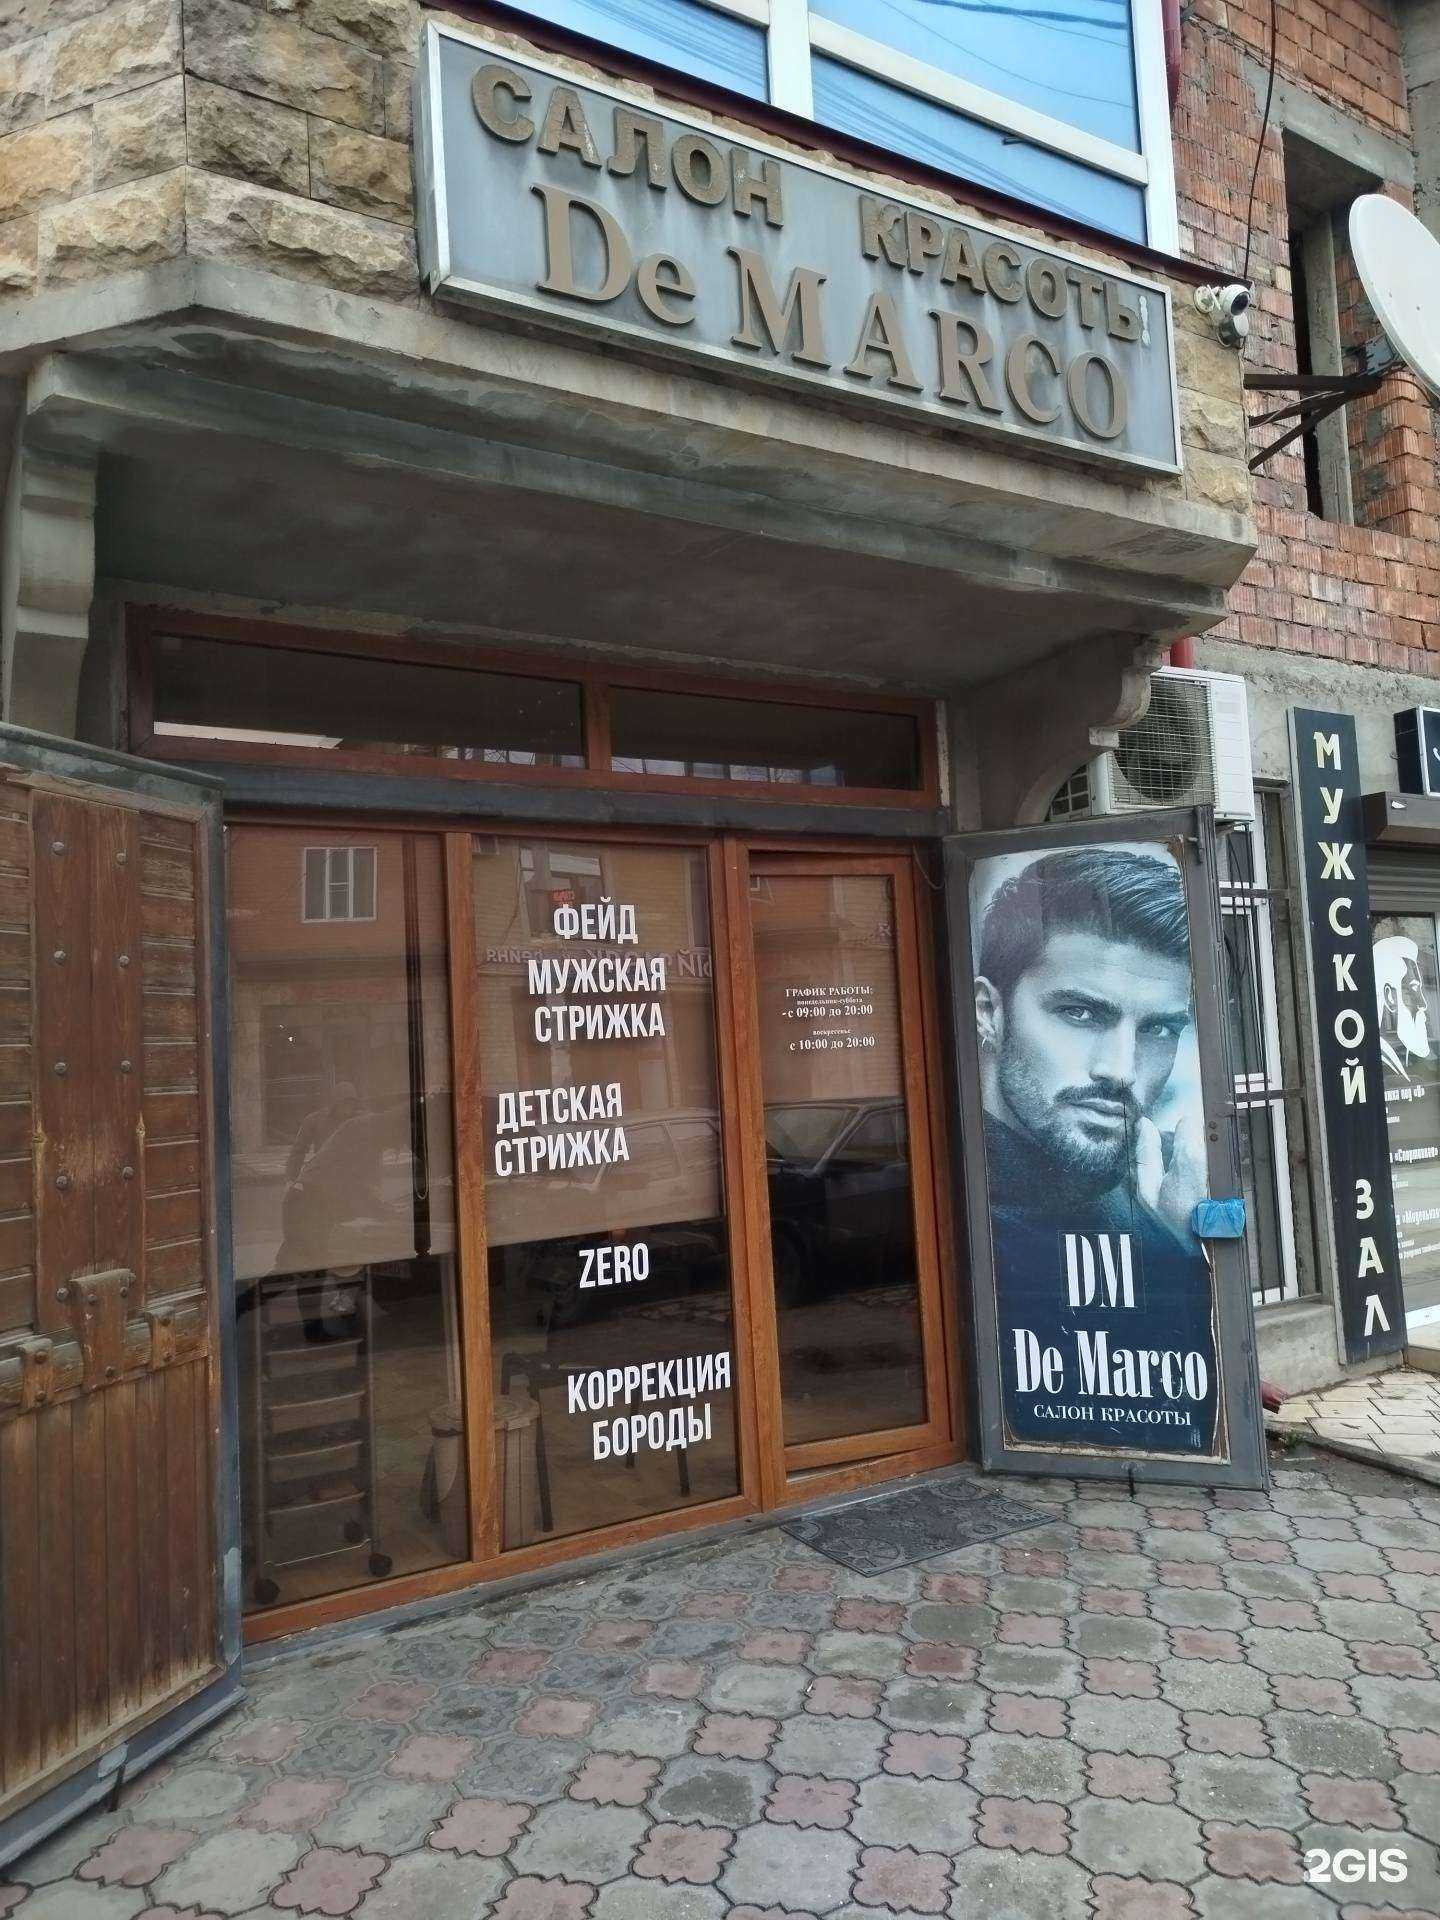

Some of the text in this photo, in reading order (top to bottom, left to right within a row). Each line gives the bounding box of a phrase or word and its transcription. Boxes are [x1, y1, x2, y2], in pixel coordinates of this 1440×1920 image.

[470, 64, 784, 229] САЛОН
[530, 183, 1129, 440] De MARCO
[553, 896, 639, 944] ФЕЙД
[528, 957, 666, 995] МУЖСКАЯ
[785, 986, 873, 997] ГРАФИК РАБОТЫ:
[534, 1002, 666, 1043] СТРИЖКА
[796, 1006, 826, 1018] 09:00
[828, 1008, 841, 1018] до
[844, 1004, 873, 1016] 20:00
[1313, 731, 1391, 1337] МУЖСКОЙ ЗАЛ
[789, 1036, 875, 1050] с 10:00 до 20:00
[496, 1082, 623, 1135] ДЕТСКАЯ
[494, 1126, 630, 1177] СТРИЖКА
[579, 1242, 650, 1289] ZERO
[1063, 1233, 1138, 1308] DM
[567, 1351, 731, 1414] КОРРЕКЦИЯ
[1012, 1328, 1208, 1401] De Marco
[592, 1402, 712, 1461] БОРОДЫ
[1033, 1404, 1192, 1426] САЛОН КРАСОТЫ
